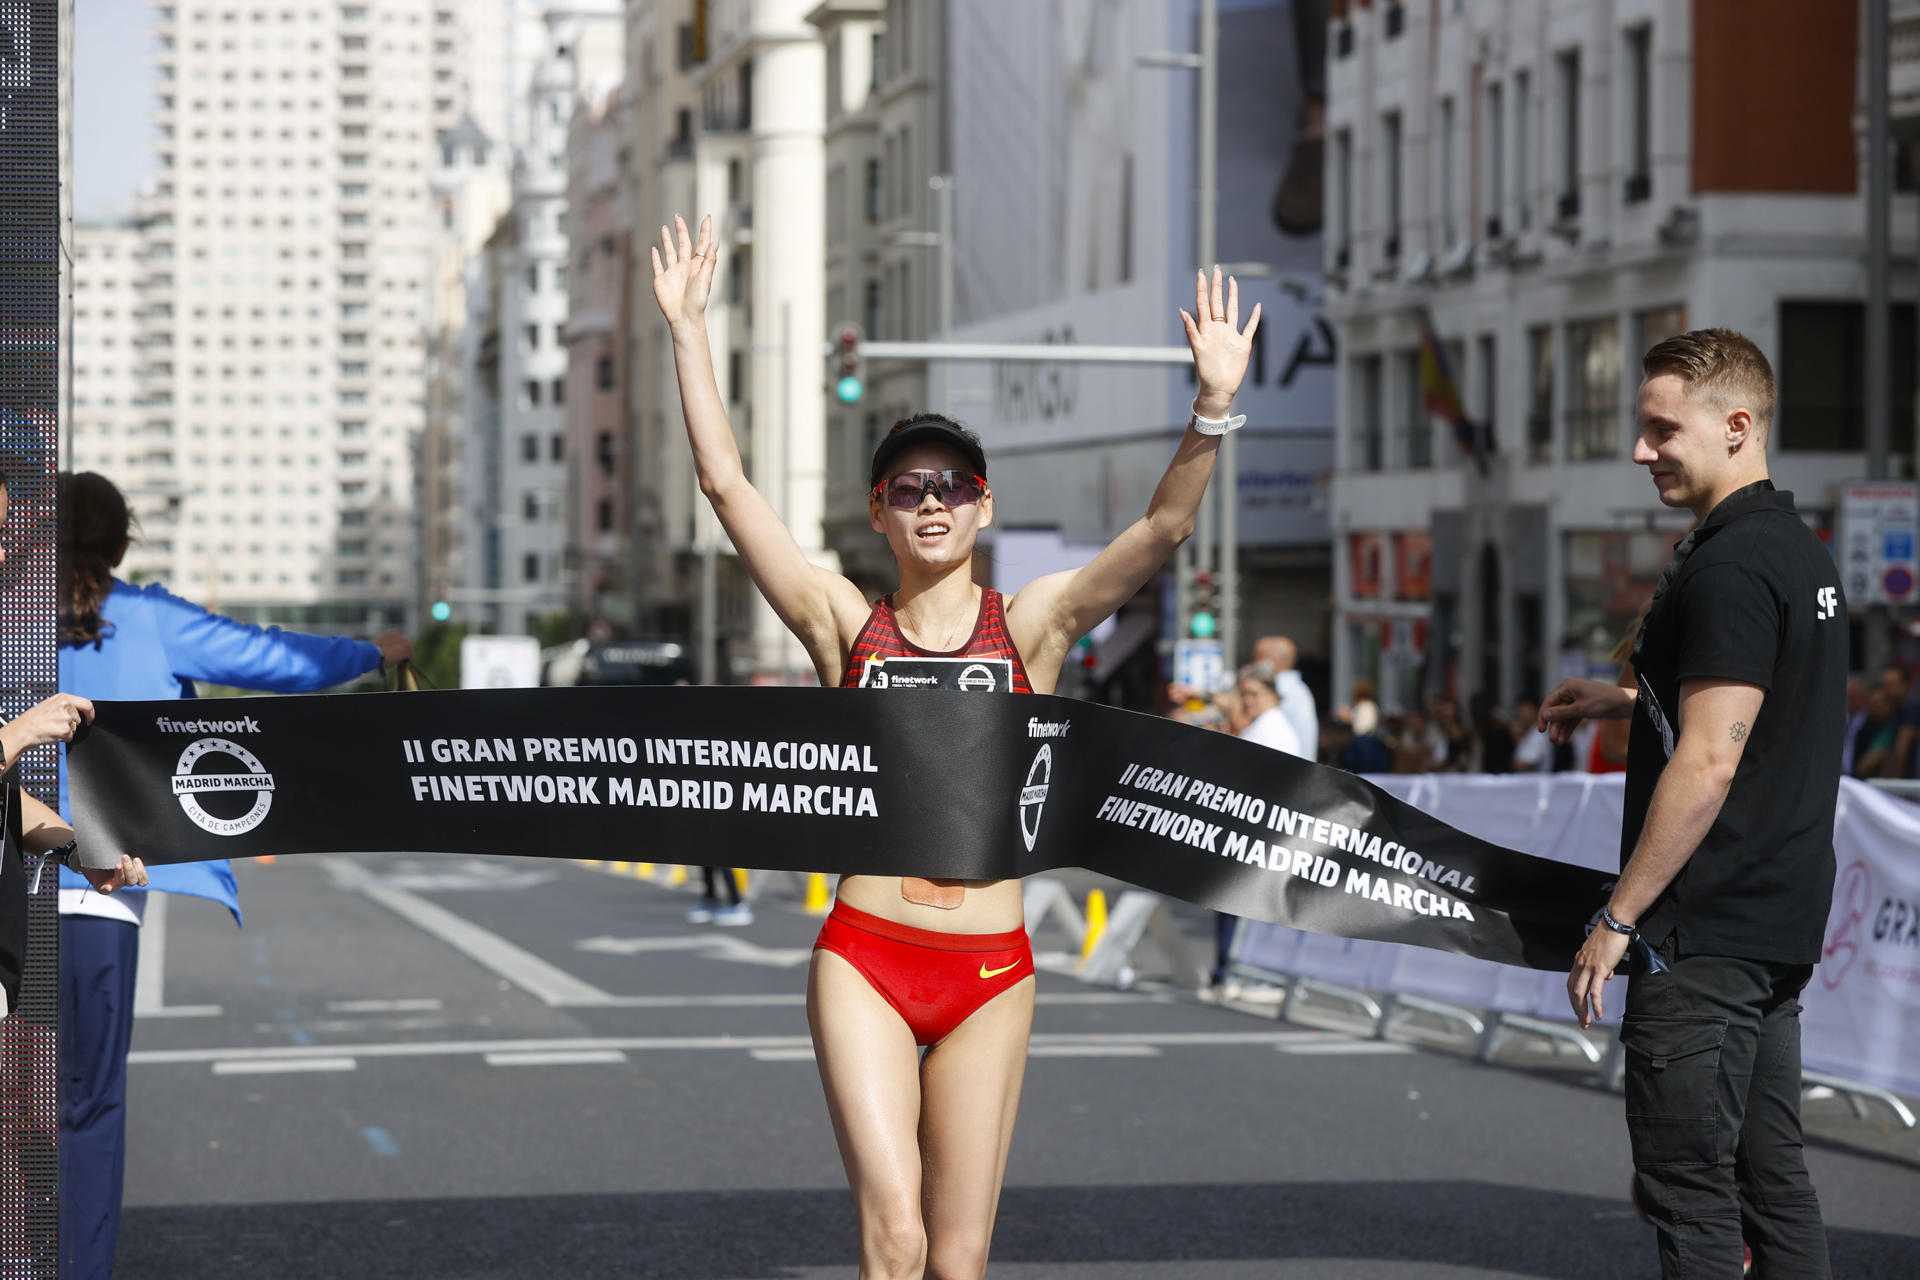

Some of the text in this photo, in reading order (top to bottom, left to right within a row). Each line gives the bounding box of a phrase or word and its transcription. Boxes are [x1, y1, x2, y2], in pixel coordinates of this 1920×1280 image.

[891, 675, 938, 684] finetwork
[156, 716, 261, 733] finetwork
[1028, 717, 1071, 737] finetwork
[403, 738, 879, 773] II GRAN PREMIO INTERNACIONAL
[175, 776, 272, 790] MADRID MARCHA
[411, 775, 879, 817] FINETWORK MADRID MARCHA
[188, 801, 267, 832] CITA DE CAMPEONES
[1118, 763, 1476, 894] II GRAN PREMIO INTERNACIONAL
[1096, 795, 1476, 922] FINETWORK MADRID MARCHA
